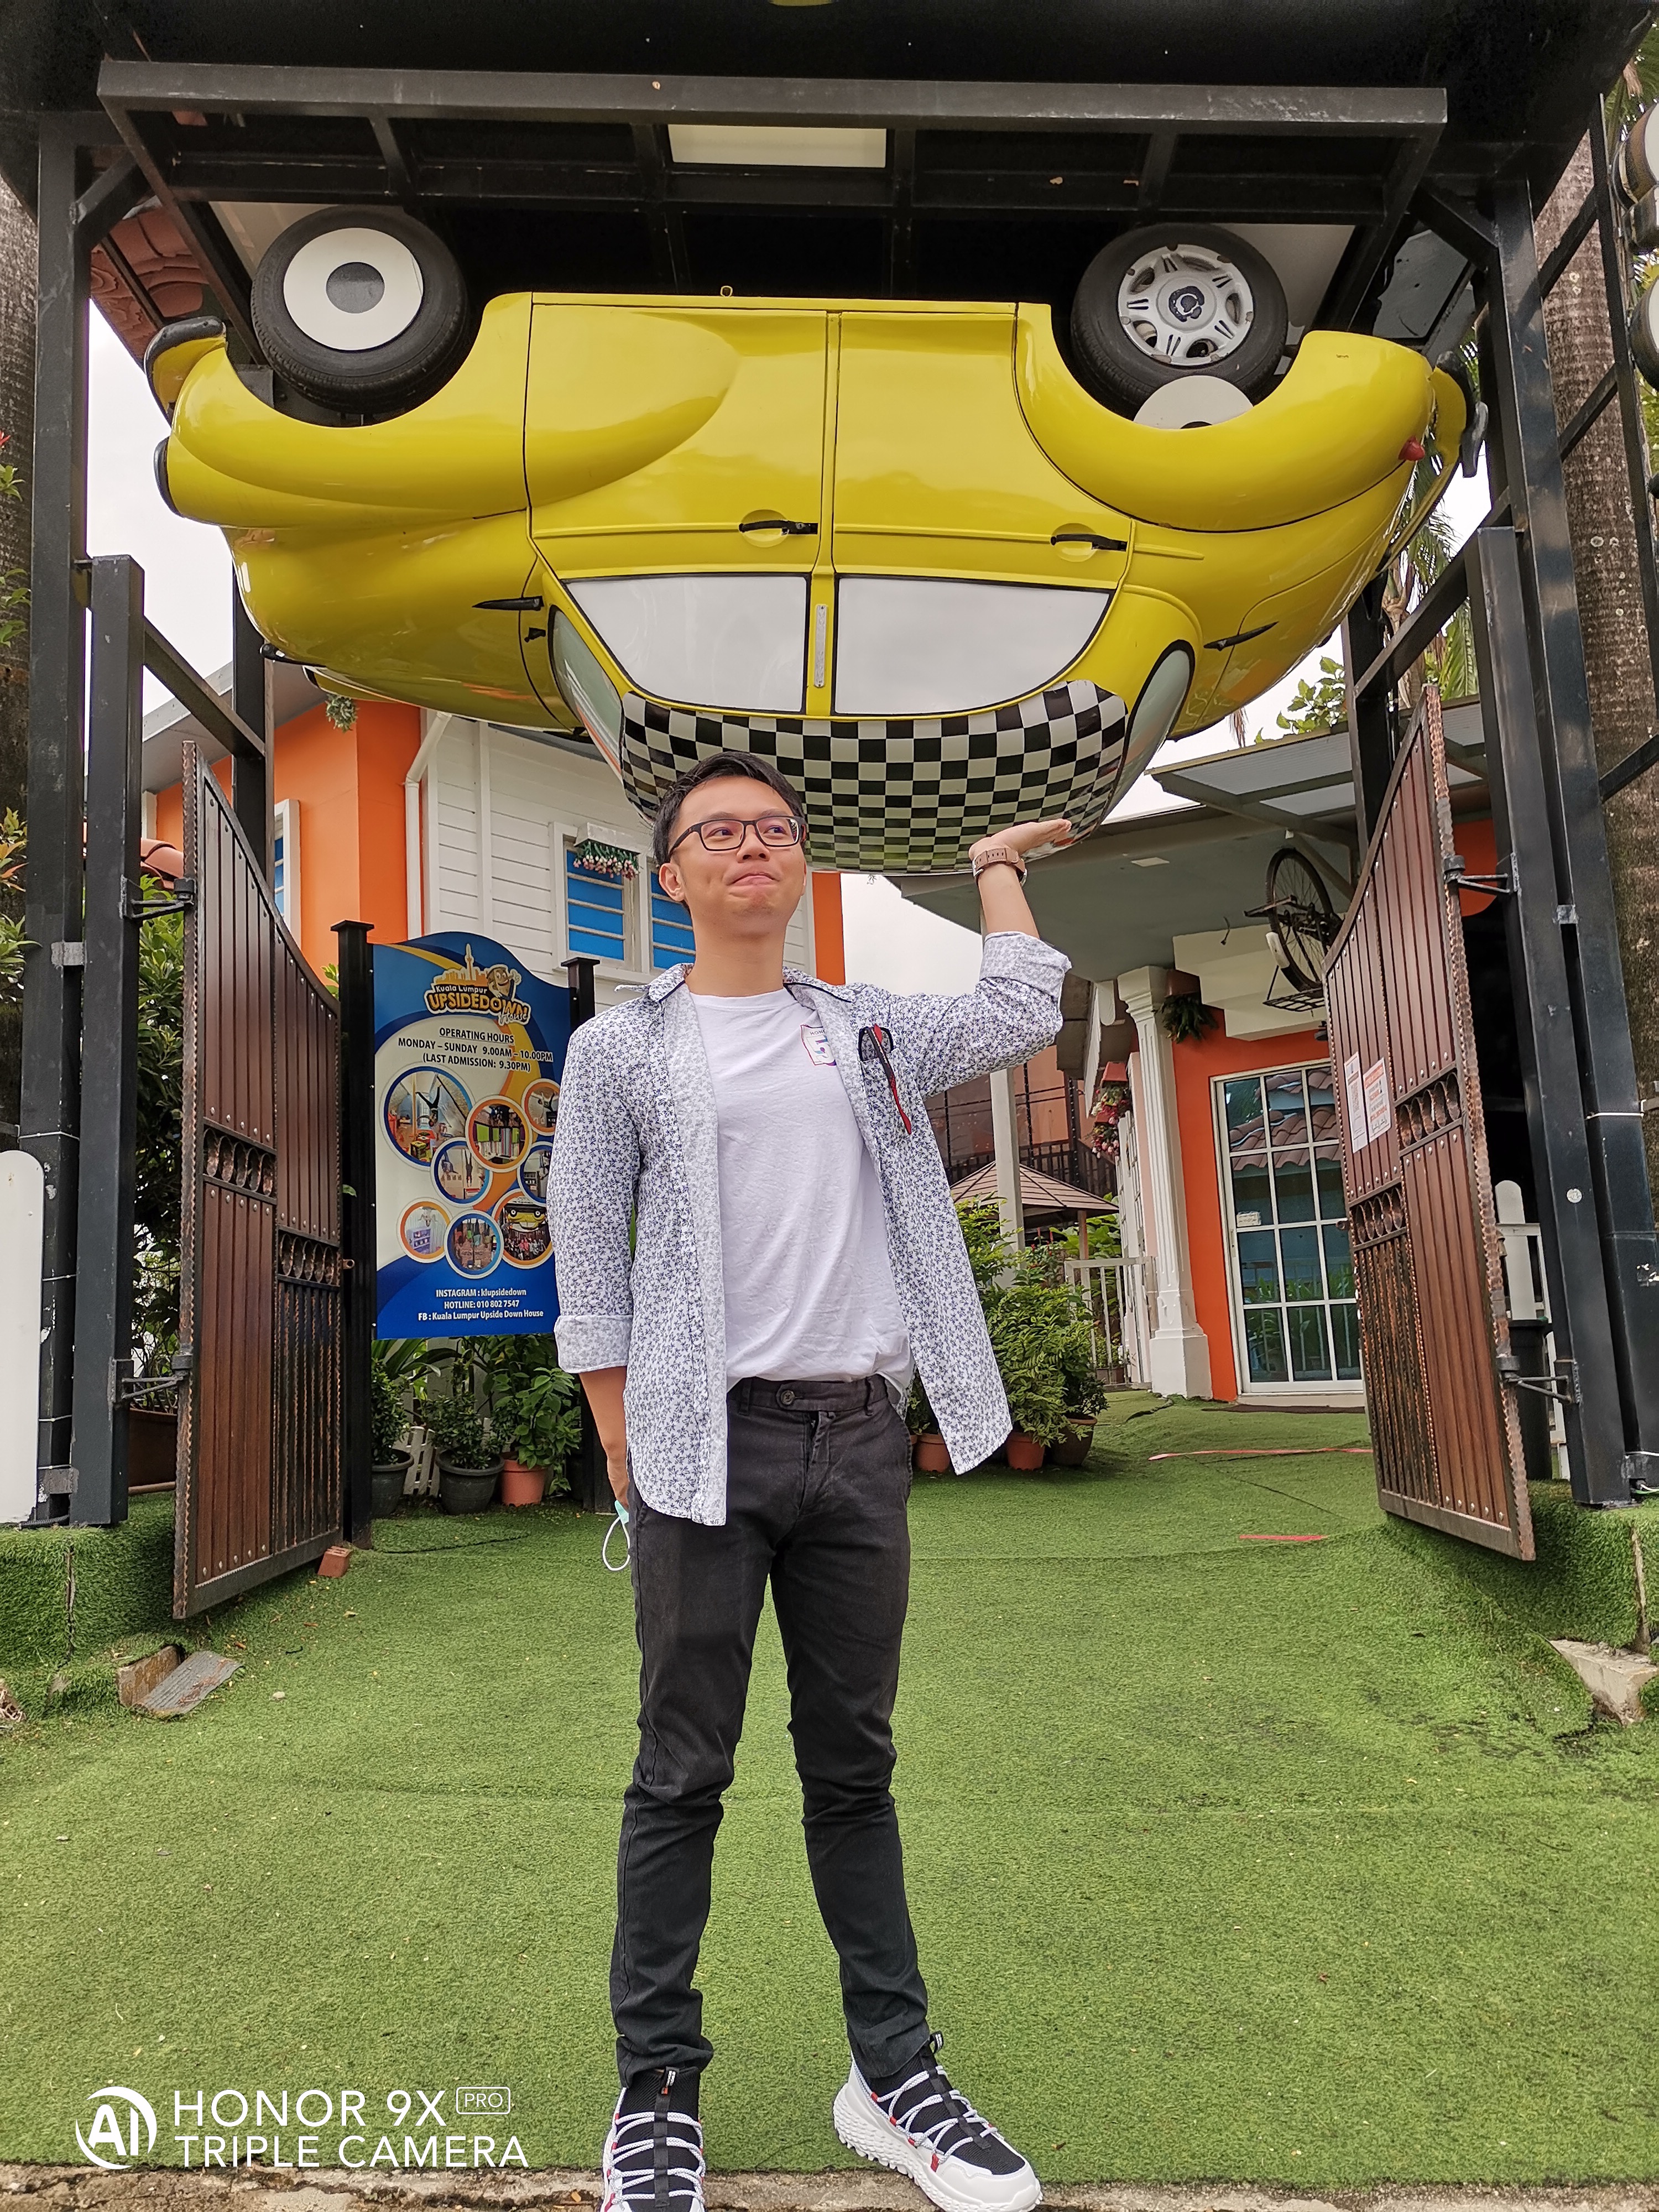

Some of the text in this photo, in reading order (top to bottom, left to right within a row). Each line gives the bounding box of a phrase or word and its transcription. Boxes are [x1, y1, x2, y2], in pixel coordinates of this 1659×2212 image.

[458, 985, 488, 994] Lumpur
[429, 993, 528, 1015] UPSIDEDOWN
[500, 1006, 527, 1023] House
[440, 1027, 514, 1044] OPERATING HOURS
[398, 1038, 436, 1050] MONDAY
[444, 1042, 477, 1053] SUNDAY
[482, 1046, 512, 1057] 9.00AM
[520, 1051, 552, 1061] 10.00PM
[423, 1053, 530, 1072] (LAST ADMISSION: 9.30PM)
[436, 1289, 476, 1297] INSTAGRAM
[481, 1288, 526, 1297] klupsidedown
[504, 1300, 519, 1308] 7547
[418, 1313, 427, 1321] FB
[453, 1312, 479, 1321] Lumpur
[480, 1311, 503, 1321] Upside
[524, 1309, 544, 1317] House
